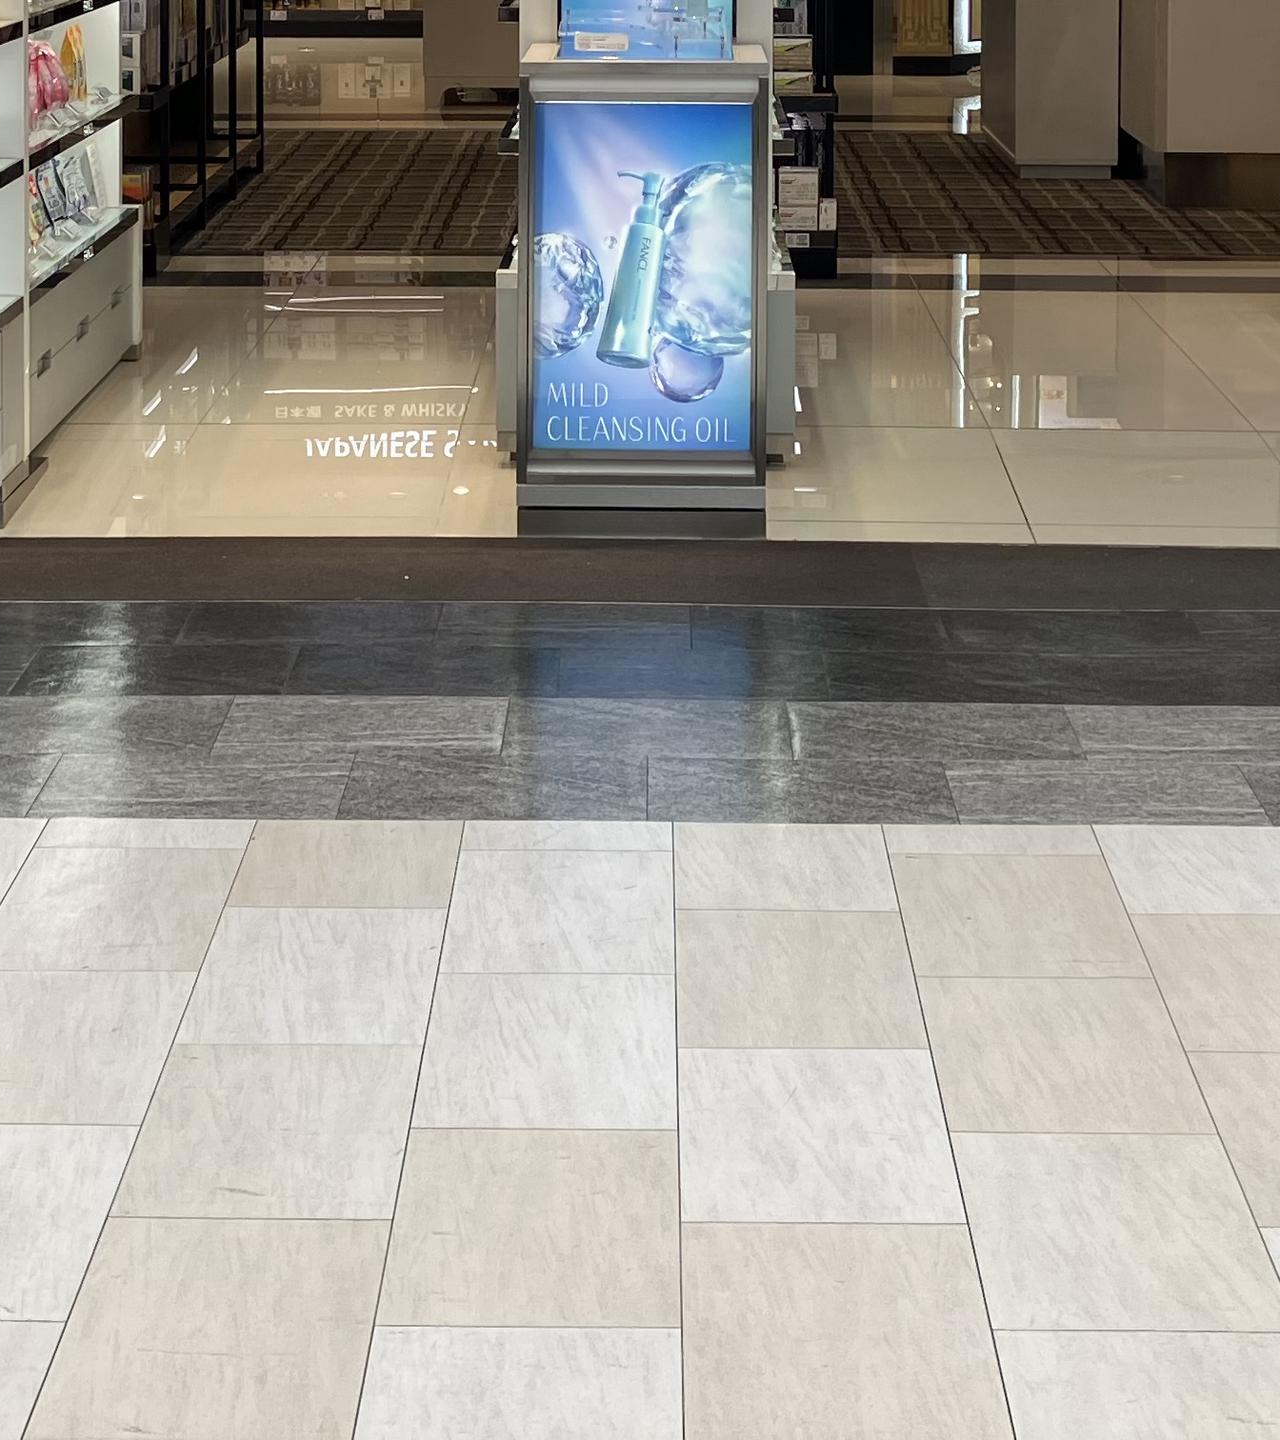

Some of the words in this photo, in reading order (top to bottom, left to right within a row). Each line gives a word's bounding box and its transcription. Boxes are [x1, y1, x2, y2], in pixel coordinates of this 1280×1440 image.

[636, 236, 652, 273] FANCL
[546, 382, 609, 409] MILD
[545, 415, 687, 443] CLEANSING
[695, 416, 737, 443] OIL
